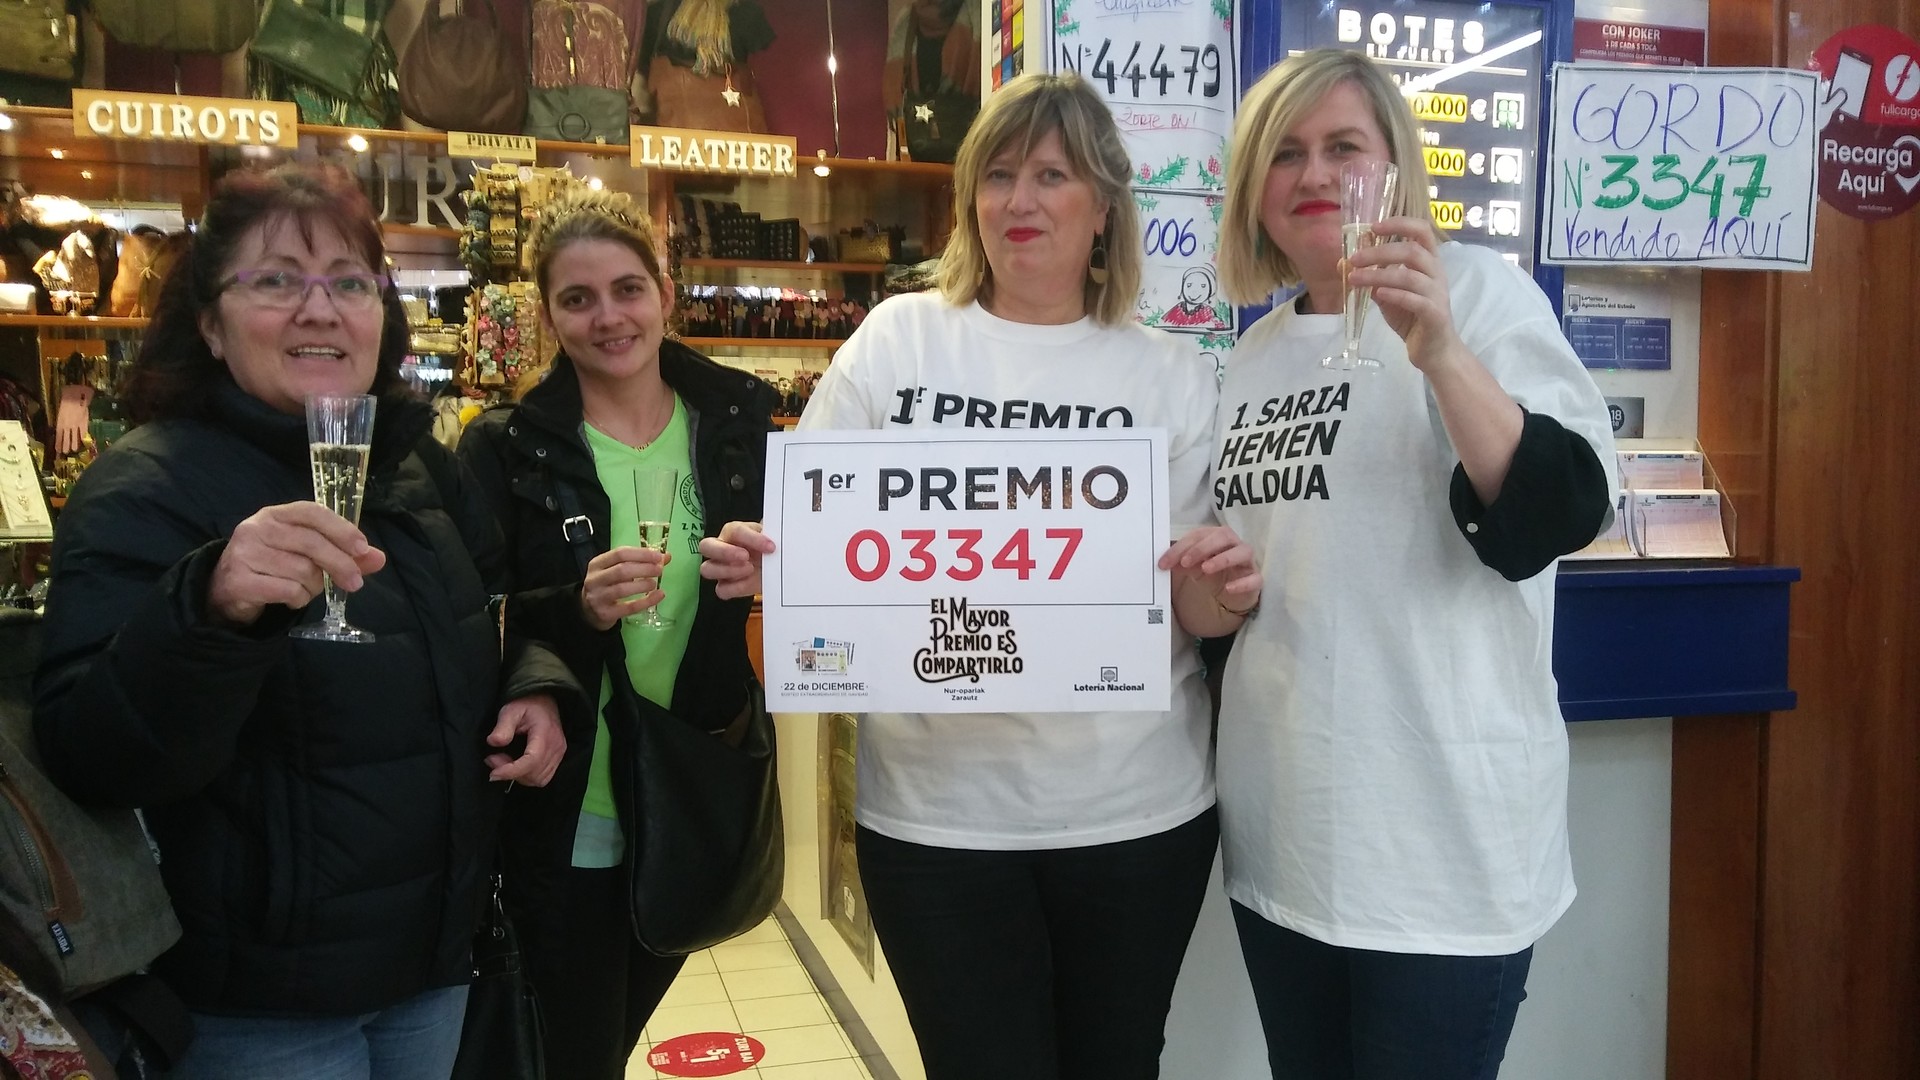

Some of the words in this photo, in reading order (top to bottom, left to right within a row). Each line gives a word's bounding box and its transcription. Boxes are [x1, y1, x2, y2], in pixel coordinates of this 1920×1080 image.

[1338, 9, 1485, 54] BOTES
[1602, 24, 1626, 38] CON
[1628, 27, 1661, 41] JOKER
[1619, 41, 1636, 50] CADA
[1641, 43, 1657, 52] TOCA
[1092, 38, 1221, 98] 44479
[87, 99, 281, 145] CUIROTS
[1573, 83, 1805, 154] GORDO
[466, 134, 532, 149] PRIVATA
[640, 133, 795, 175] LEATHER
[1823, 139, 1912, 172] Recarga
[1592, 154, 1772, 219] 3347
[1838, 168, 1887, 198] Aquí
[1144, 217, 1197, 257] 006
[1565, 210, 1681, 258] Vendido
[1697, 212, 1792, 260] AQUÍ
[1230, 402, 1250, 431] 1.
[1255, 382, 1350, 427] SARIA
[1218, 420, 1342, 471] HEMEN
[804, 467, 856, 512] 1er
[878, 465, 1129, 511] PREMIO
[1213, 464, 1330, 511] SALDUA
[845, 528, 1084, 582] 03347
[930, 598, 948, 614] EL
[949, 597, 1010, 634] MAYOR
[930, 617, 992, 655] PREMIO
[784, 682, 796, 691] 22
[797, 682, 810, 691] de
[811, 682, 865, 691] DICIEMBRE
[913, 647, 1024, 684] COMPARTIRLO
[1107, 683, 1145, 692] Nacional
